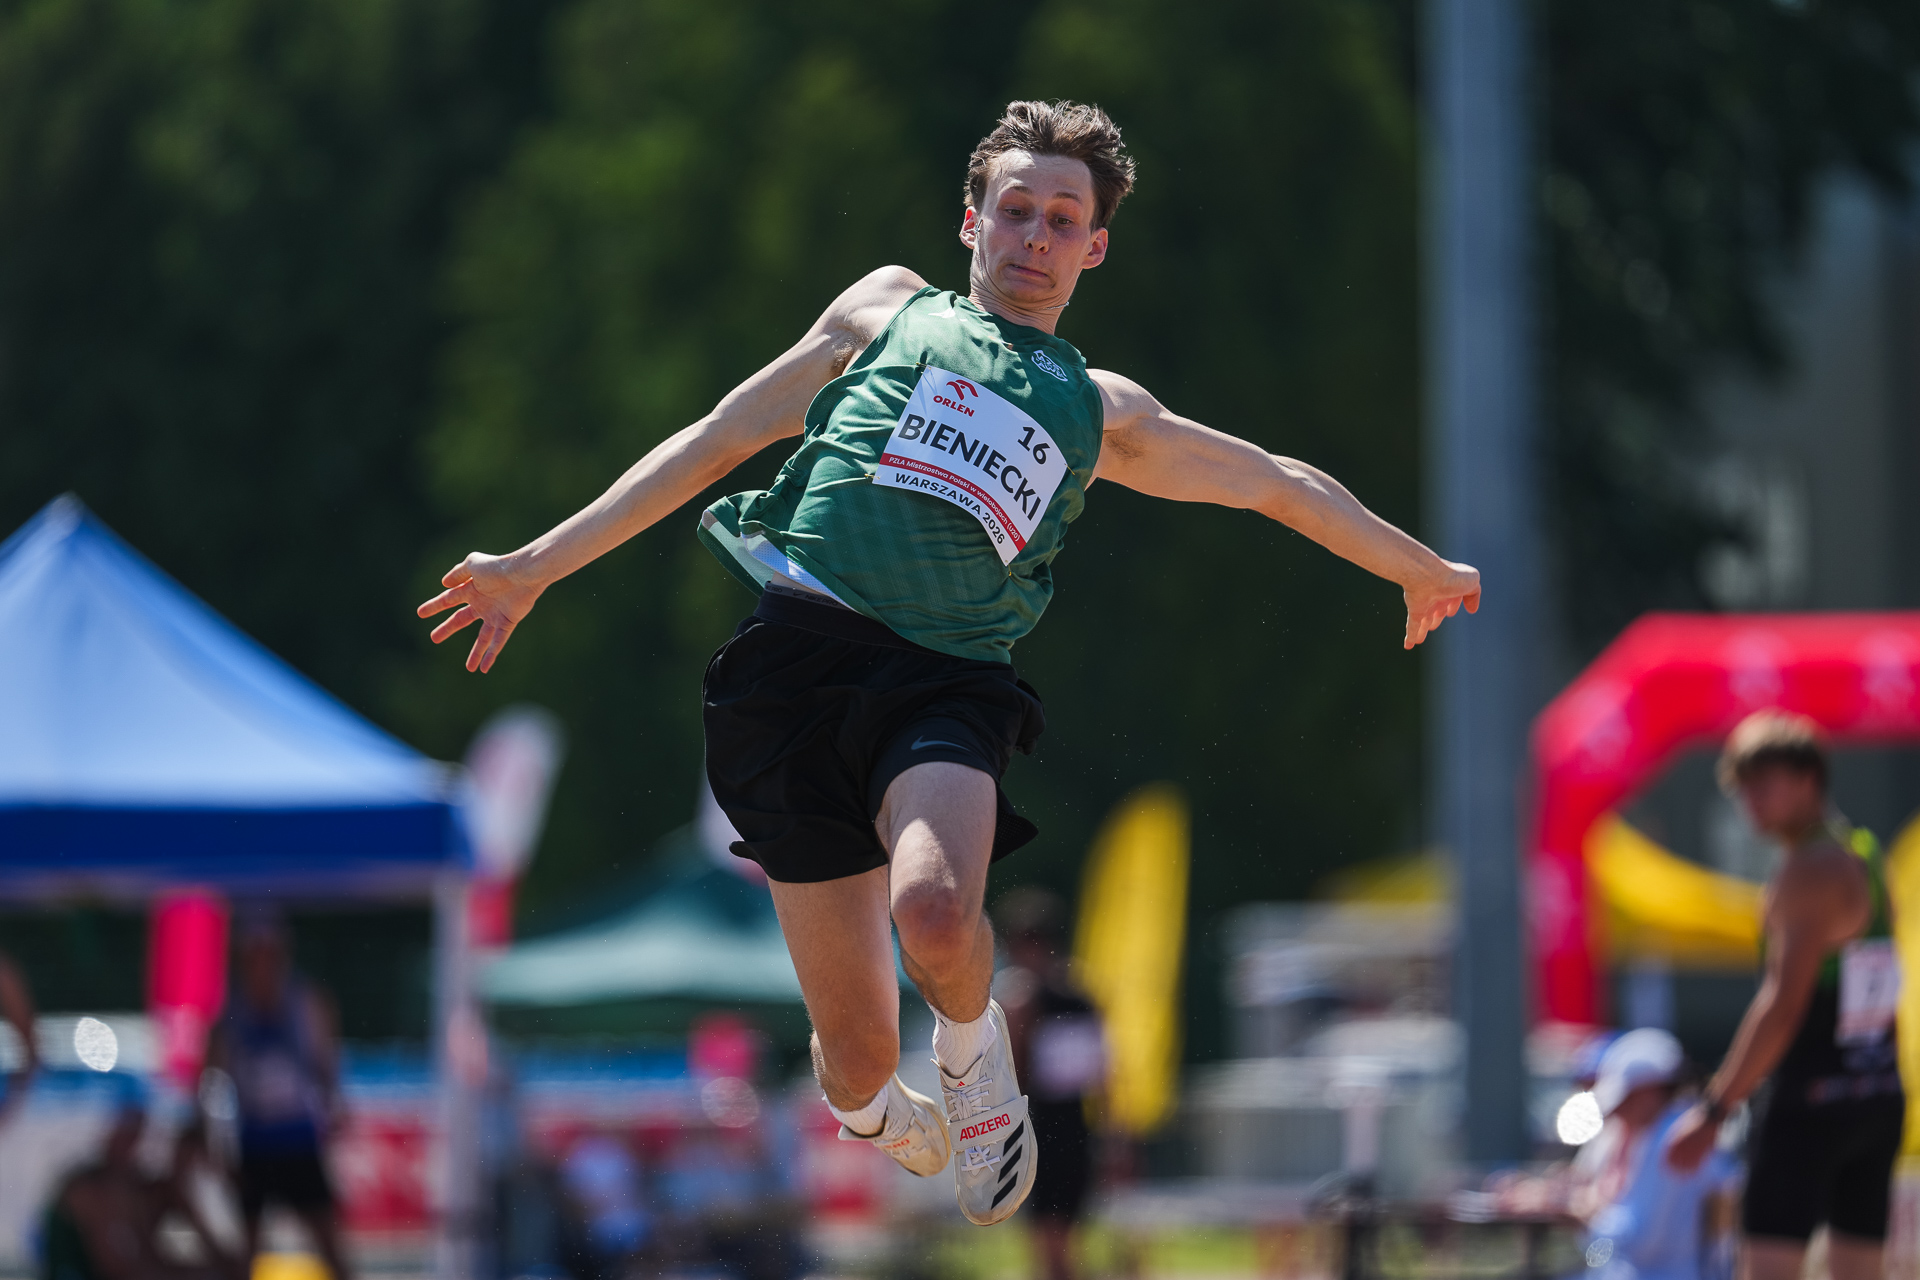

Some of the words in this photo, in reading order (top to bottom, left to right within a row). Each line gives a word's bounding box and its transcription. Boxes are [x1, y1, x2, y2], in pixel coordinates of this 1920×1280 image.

[933, 395, 975, 417] ORLEN
[898, 413, 1041, 521] BIENIECKI
[1017, 426, 1050, 465] 16
[889, 456, 905, 466] PZLA
[906, 460, 949, 479] Mistrzostwa
[949, 475, 970, 489] Polski
[977, 490, 1008, 525] wielobojach
[895, 472, 981, 515] WARSZAWA
[982, 512, 1005, 544] 2026
[959, 1113, 1011, 1142] ADIZERO
